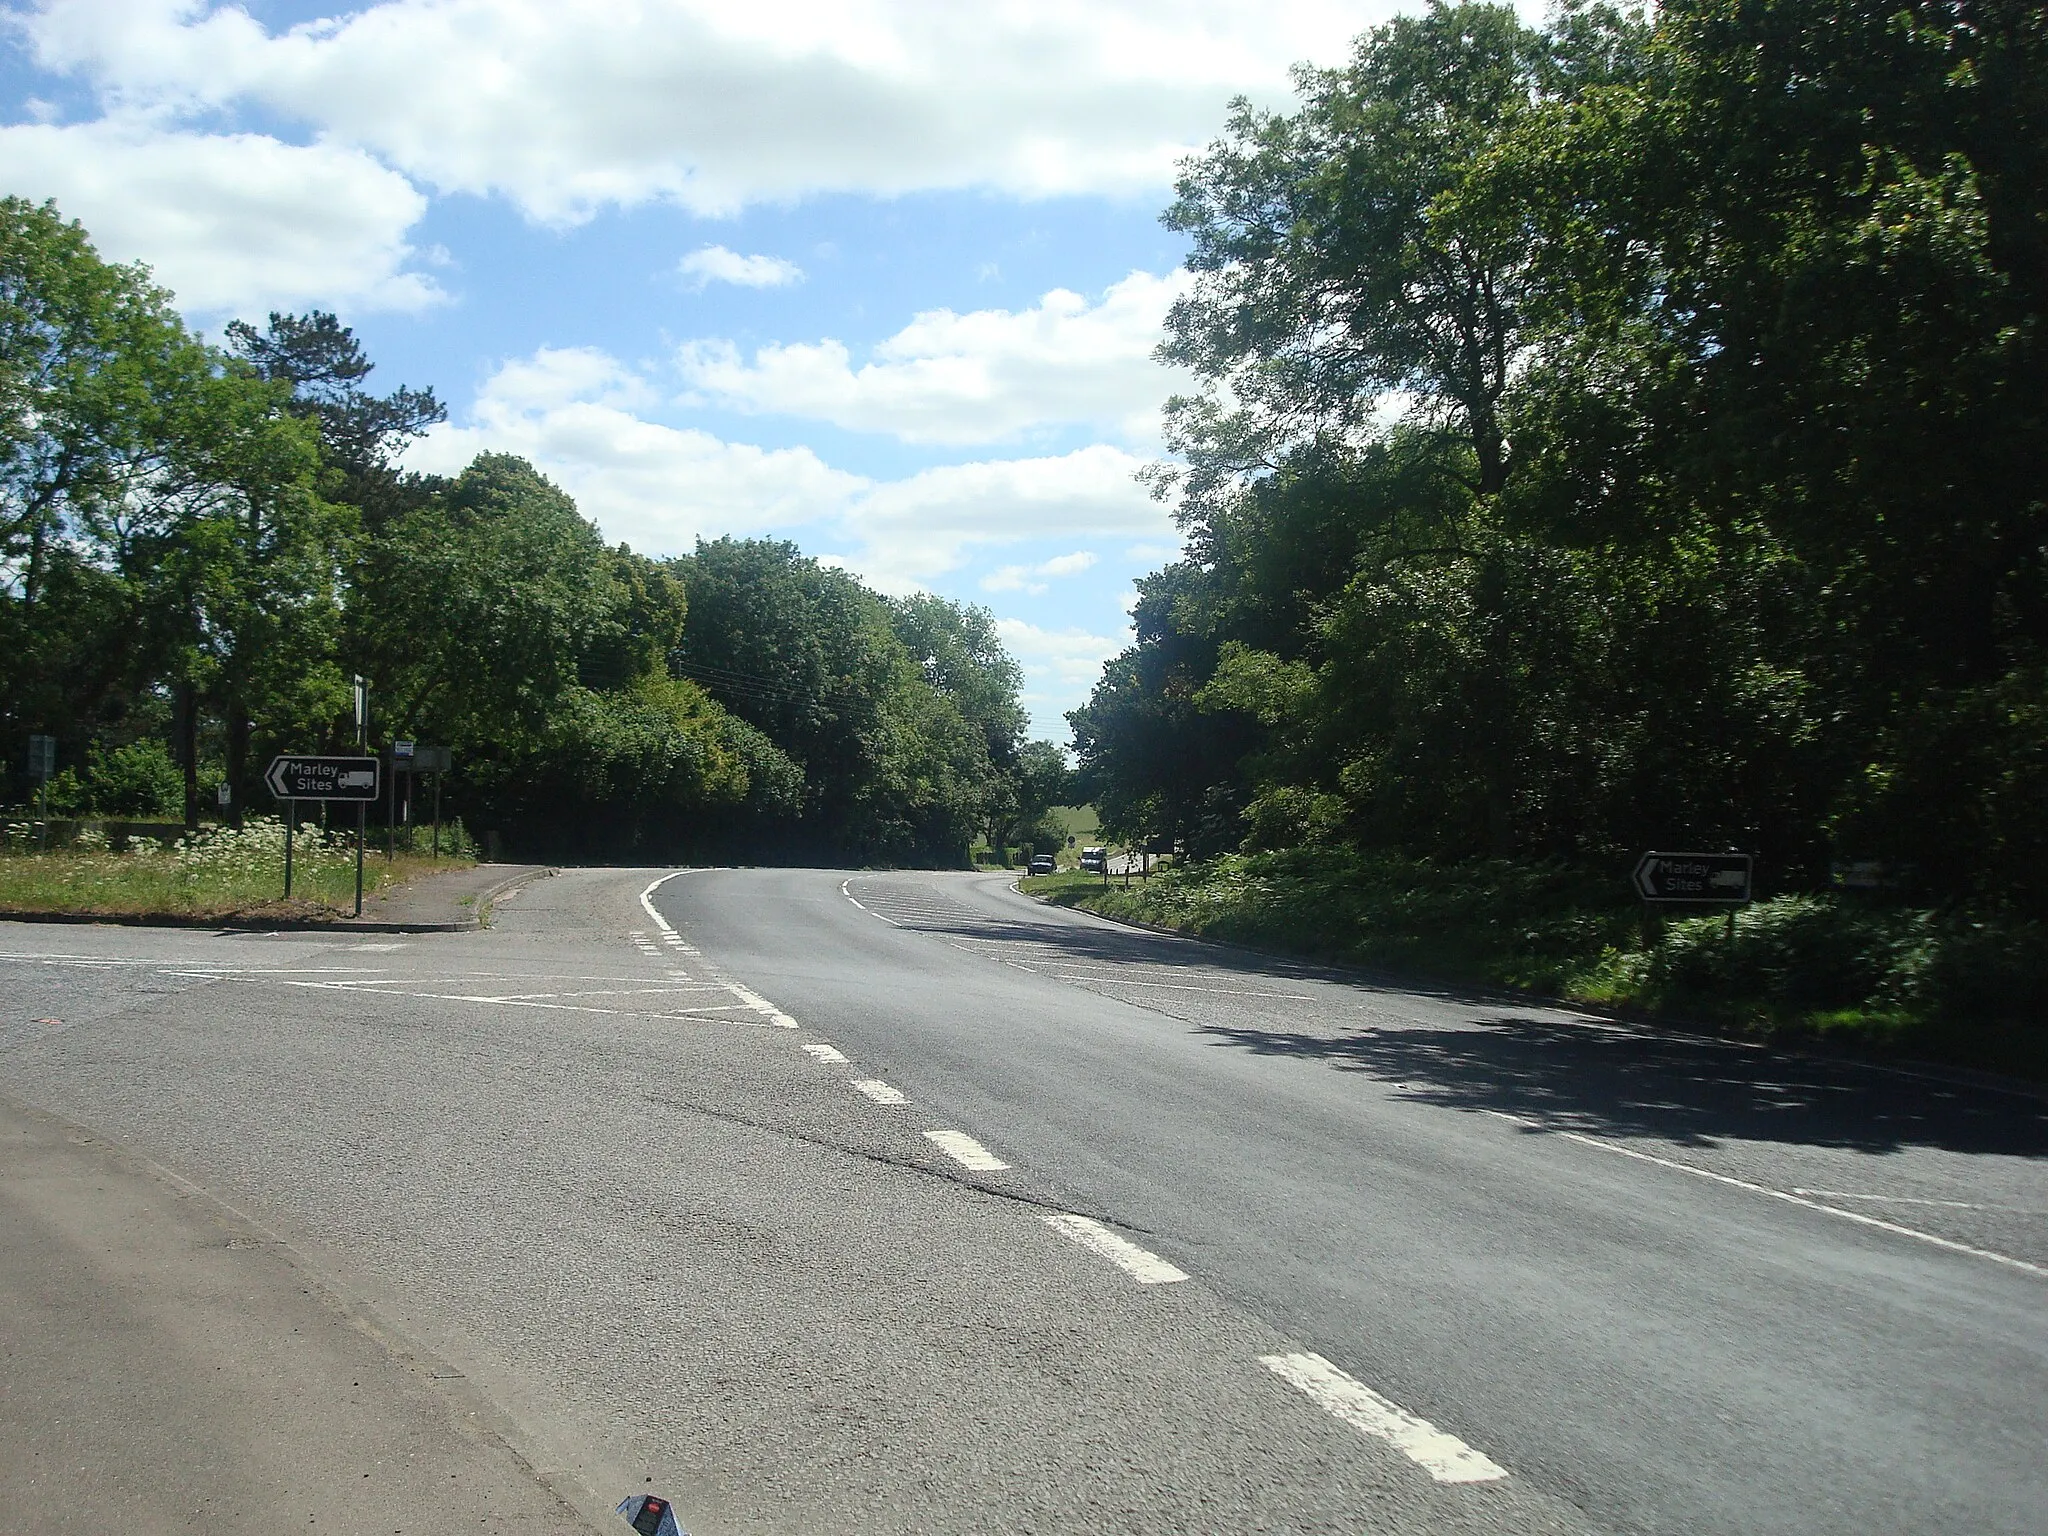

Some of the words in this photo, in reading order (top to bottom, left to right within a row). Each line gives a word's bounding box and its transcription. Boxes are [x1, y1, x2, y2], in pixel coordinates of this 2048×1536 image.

[290, 763, 338, 777] Marley
[296, 778, 332, 791] Sites
[1660, 860, 1709, 876] Marley
[1665, 877, 1702, 891] Sites
